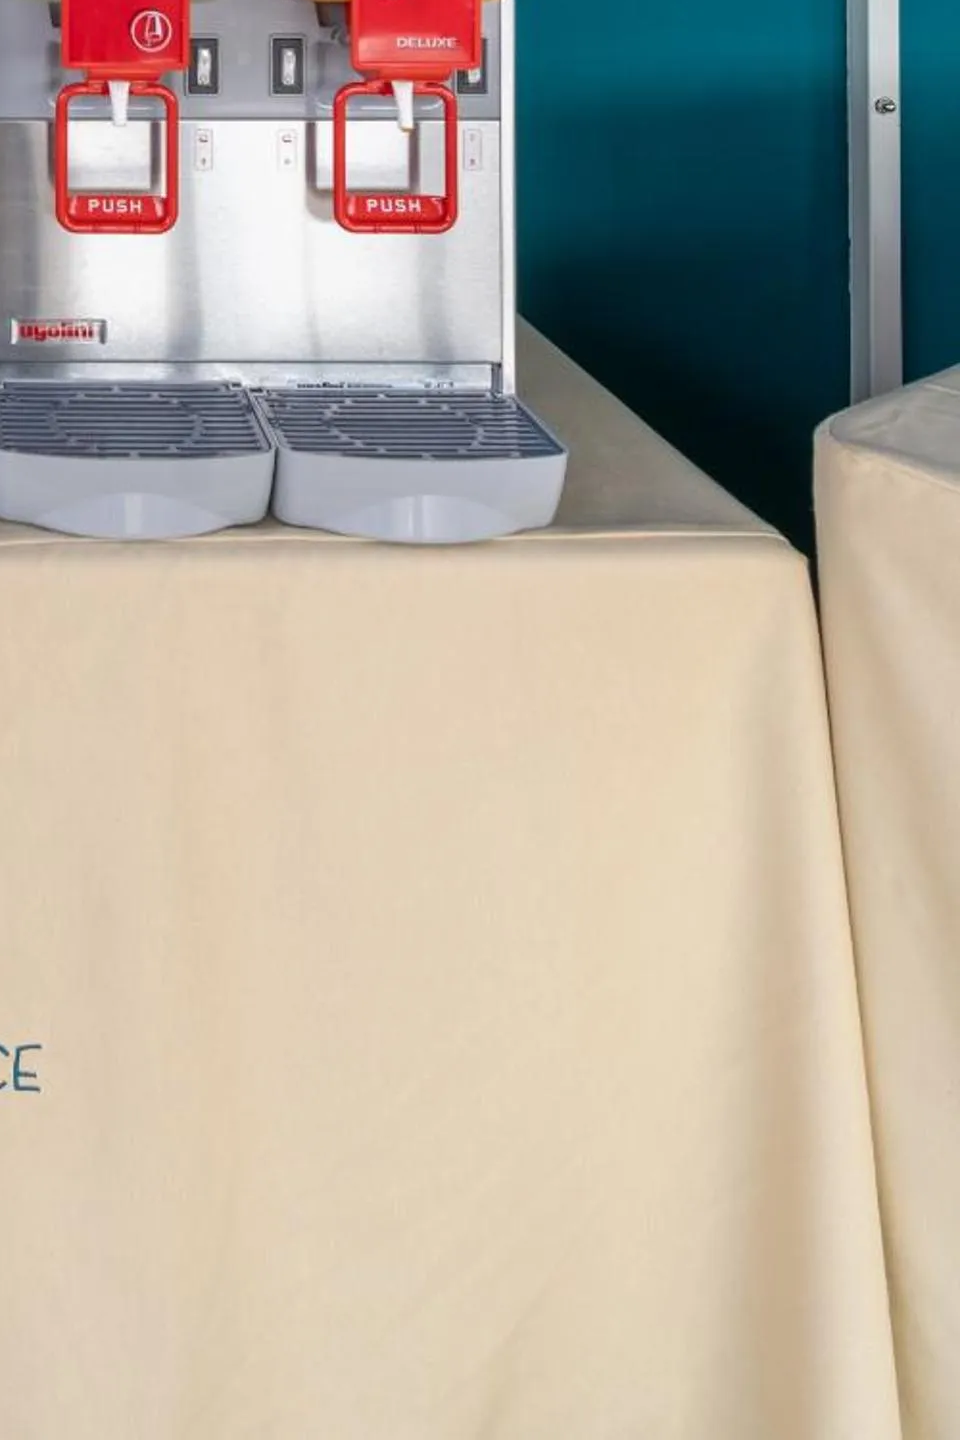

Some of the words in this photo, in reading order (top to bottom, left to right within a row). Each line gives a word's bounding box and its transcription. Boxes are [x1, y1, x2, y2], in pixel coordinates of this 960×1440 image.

[396, 37, 457, 48] DELUXE
[87, 198, 142, 213] PUSH
[366, 198, 421, 213] PUSH
